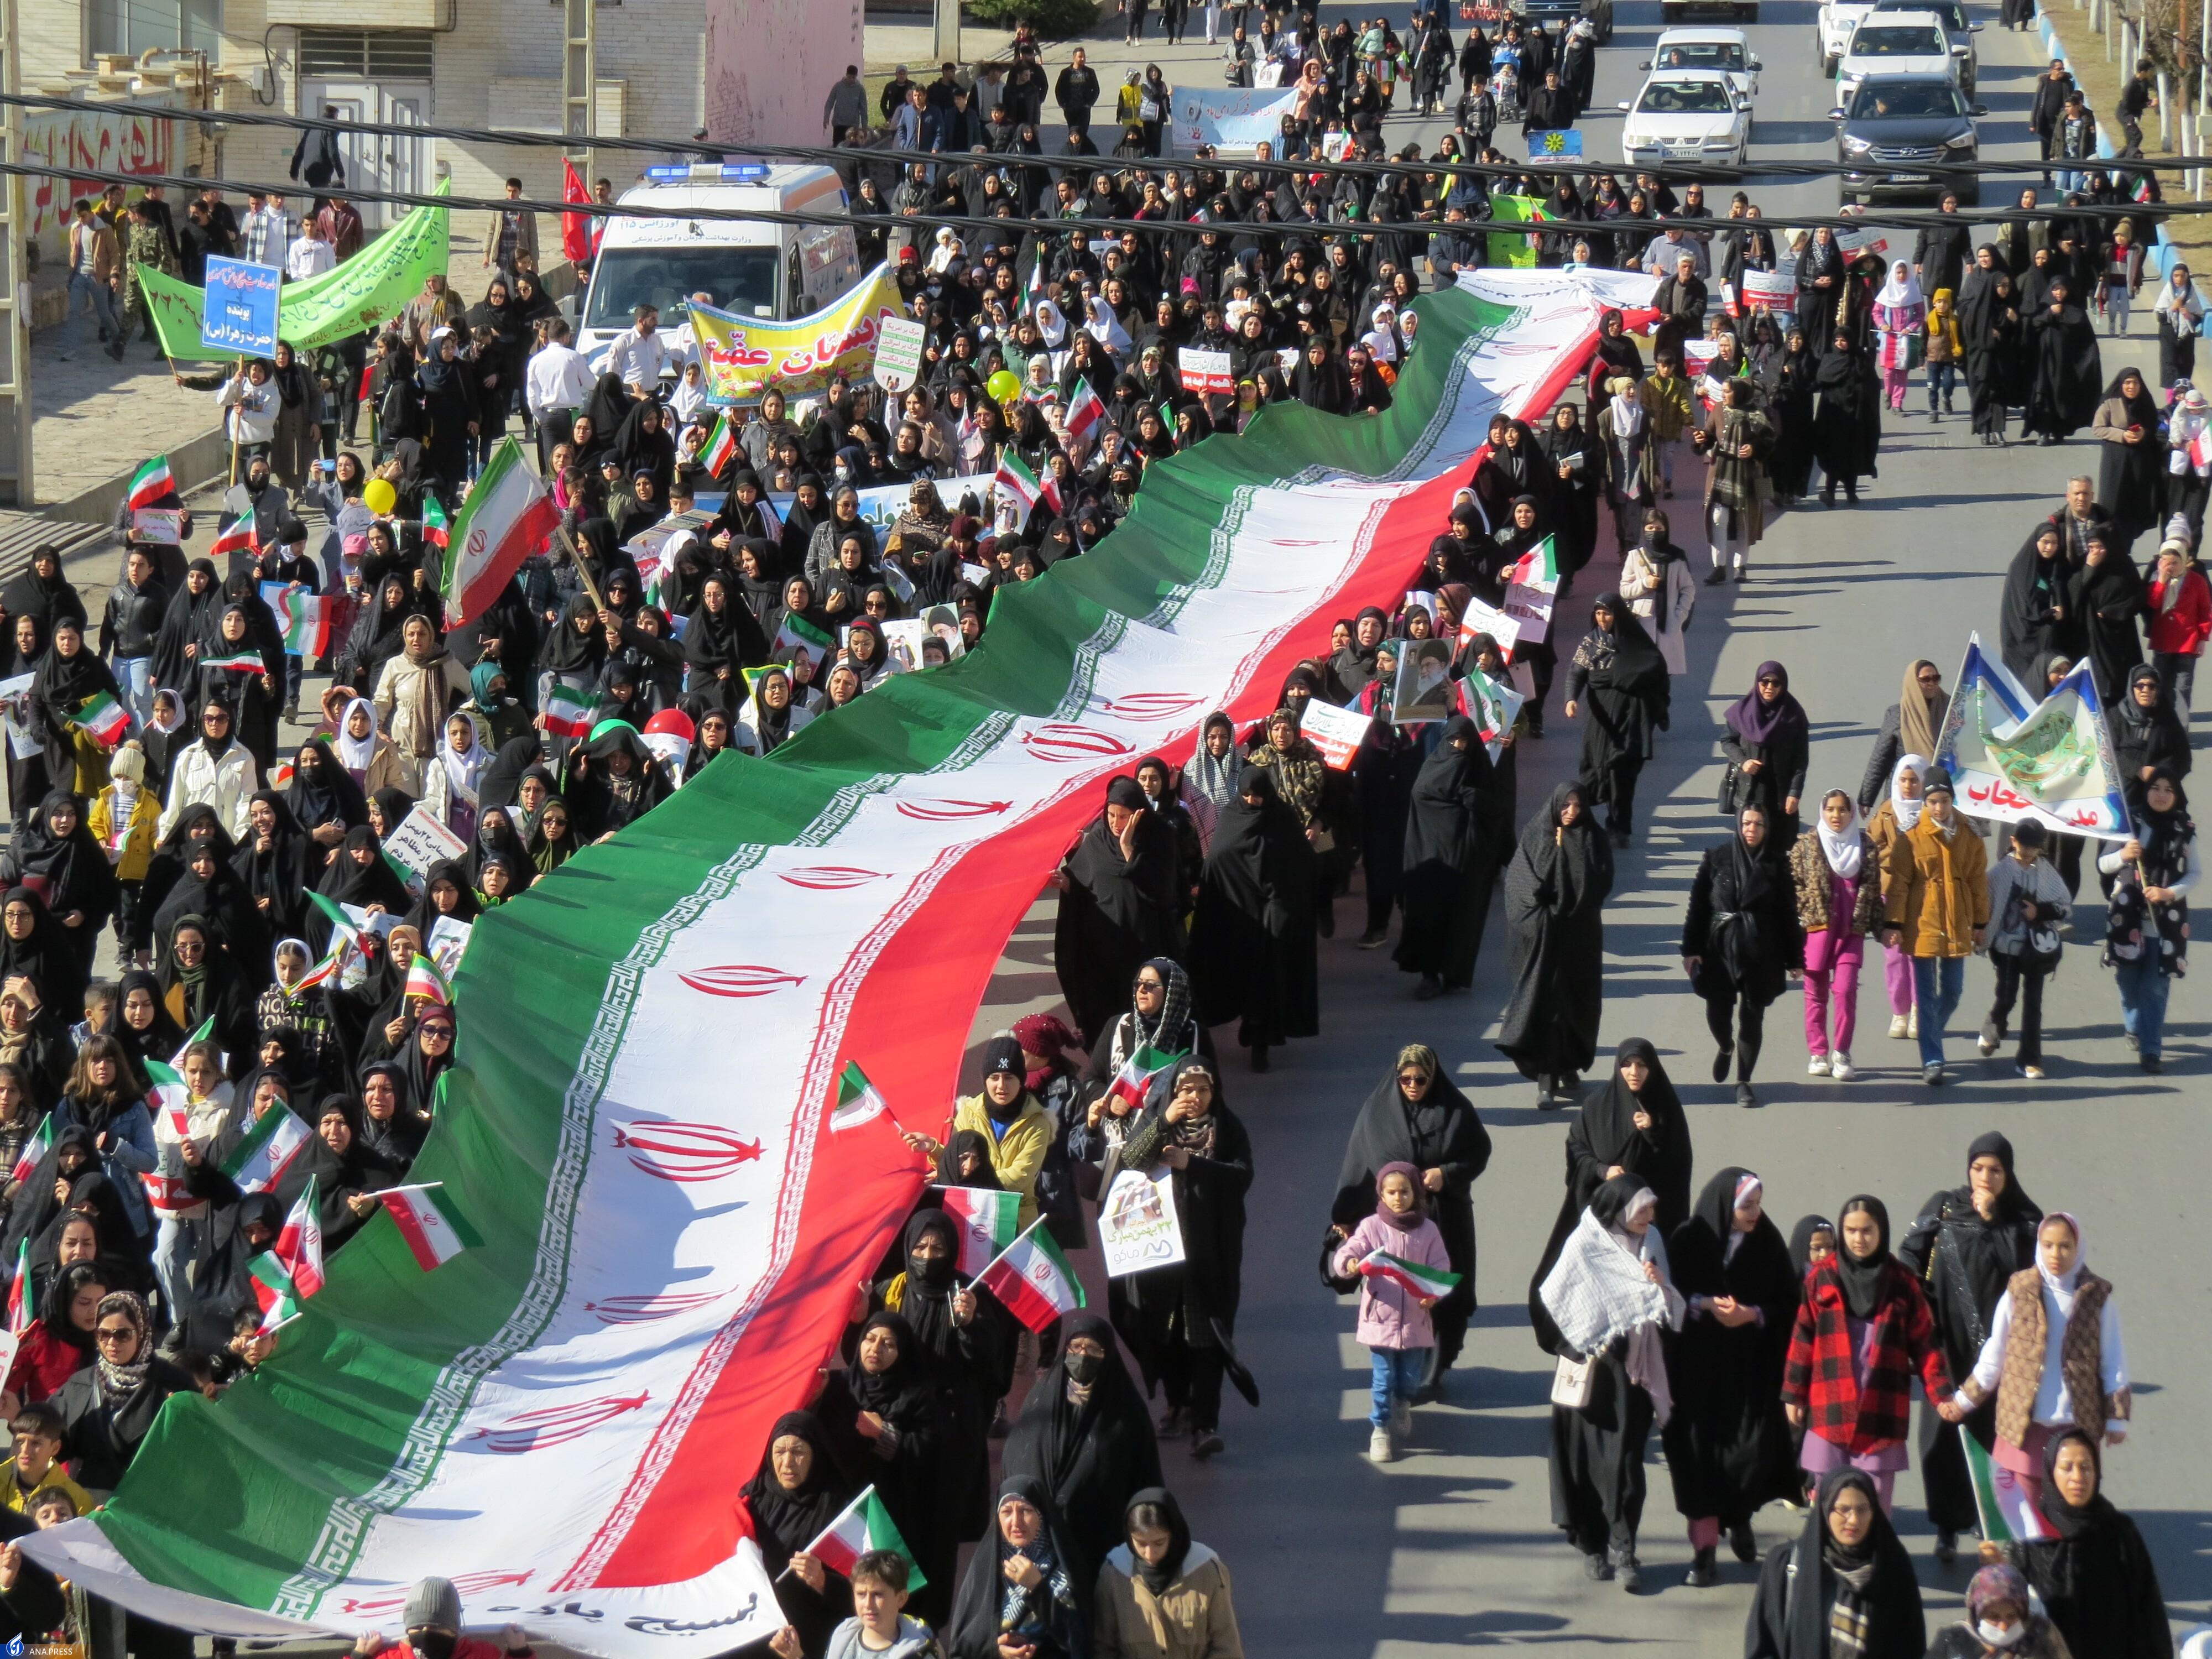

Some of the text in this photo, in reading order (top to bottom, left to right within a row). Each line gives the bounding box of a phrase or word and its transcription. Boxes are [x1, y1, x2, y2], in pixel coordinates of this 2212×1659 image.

[227, 325, 245, 345] زهرا
[246, 331, 272, 347] حضرت
[1182, 373, 1230, 388] همه آمدیم
[1968, 779, 2034, 813] حجاب
[396, 835, 422, 855] مظاهر
[1108, 1219, 1172, 1245] ۲۲ بهمن مبارک
[1114, 1249, 1140, 1265] ماکو
